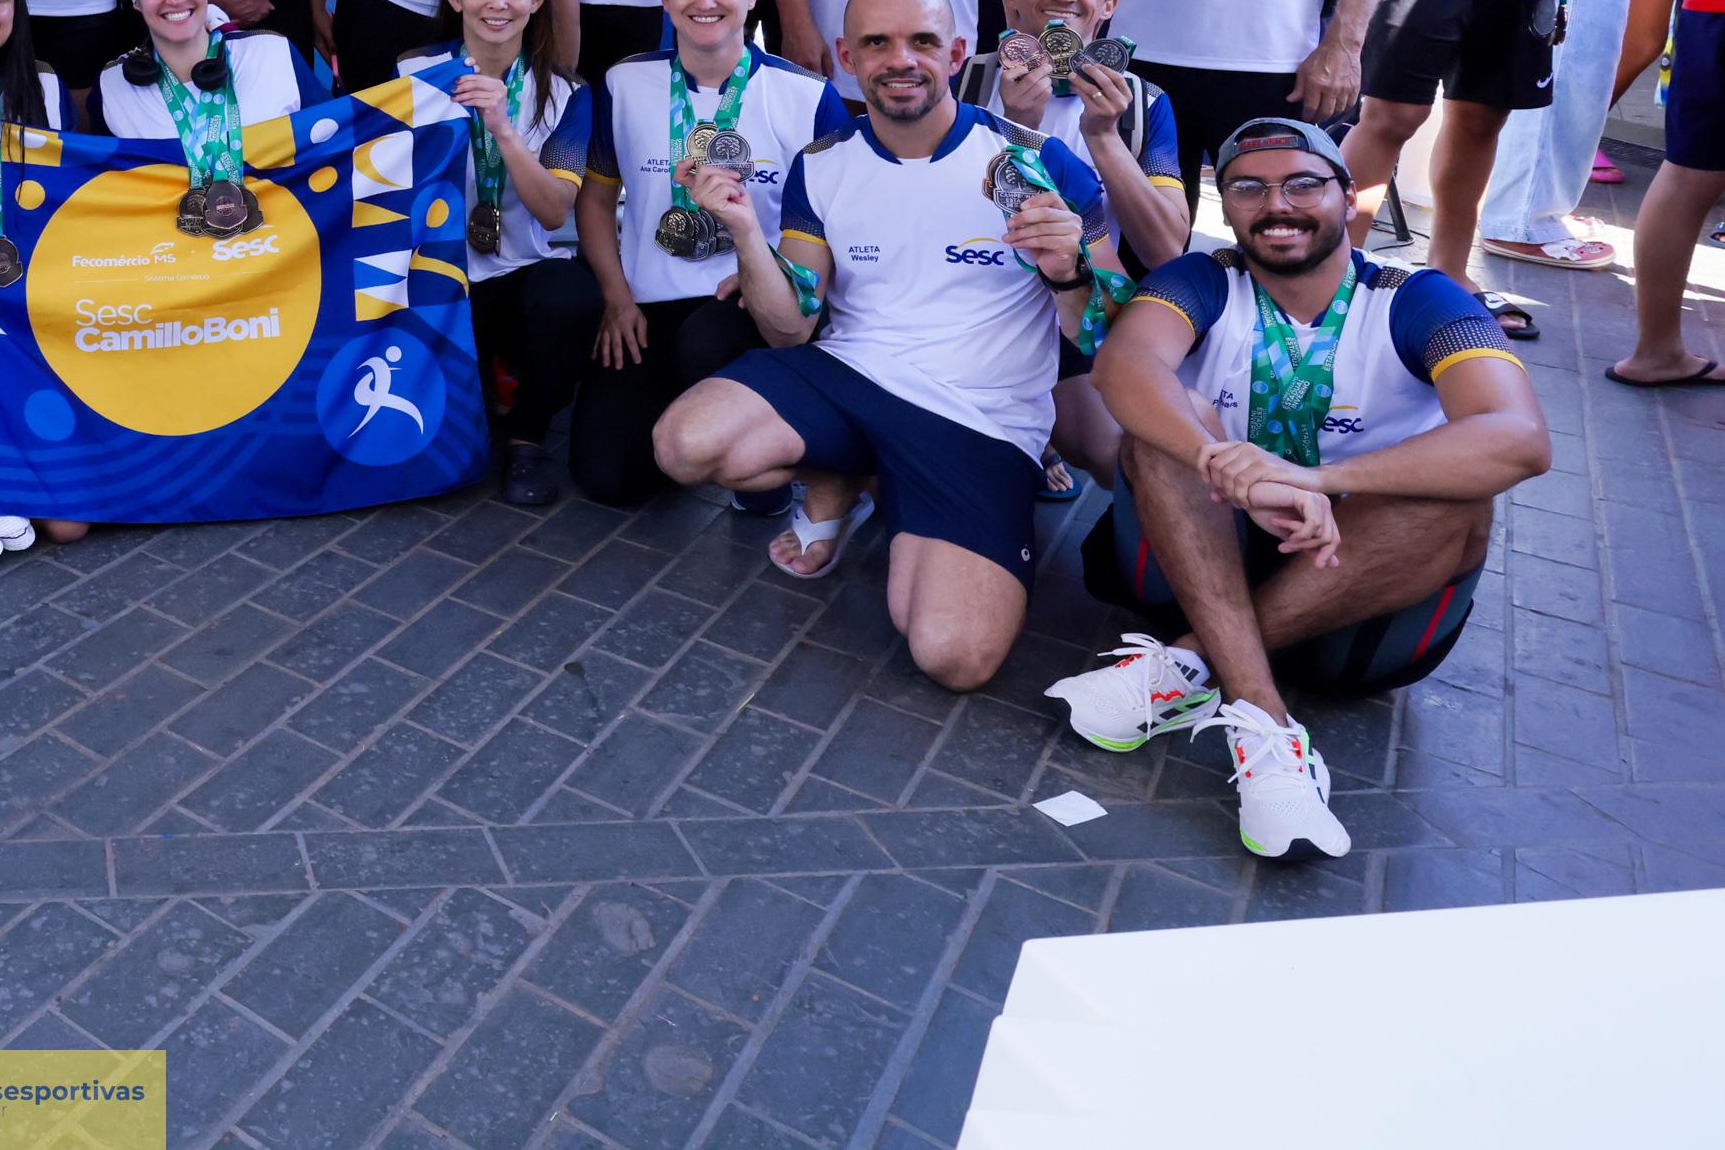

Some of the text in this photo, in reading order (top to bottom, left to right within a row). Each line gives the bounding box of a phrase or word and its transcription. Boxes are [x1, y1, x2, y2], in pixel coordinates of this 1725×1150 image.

[212, 234, 280, 261] Sesc
[849, 246, 881, 254] ATLETA
[945, 246, 1005, 266] Sesc
[72, 254, 177, 267] Fecomércio MS
[851, 254, 879, 263] Wesley
[75, 298, 153, 326] Sesc
[75, 308, 280, 352] CamilloBoni
[1285, 337, 1301, 370] ESTADUA
[1323, 416, 1365, 434] esc
